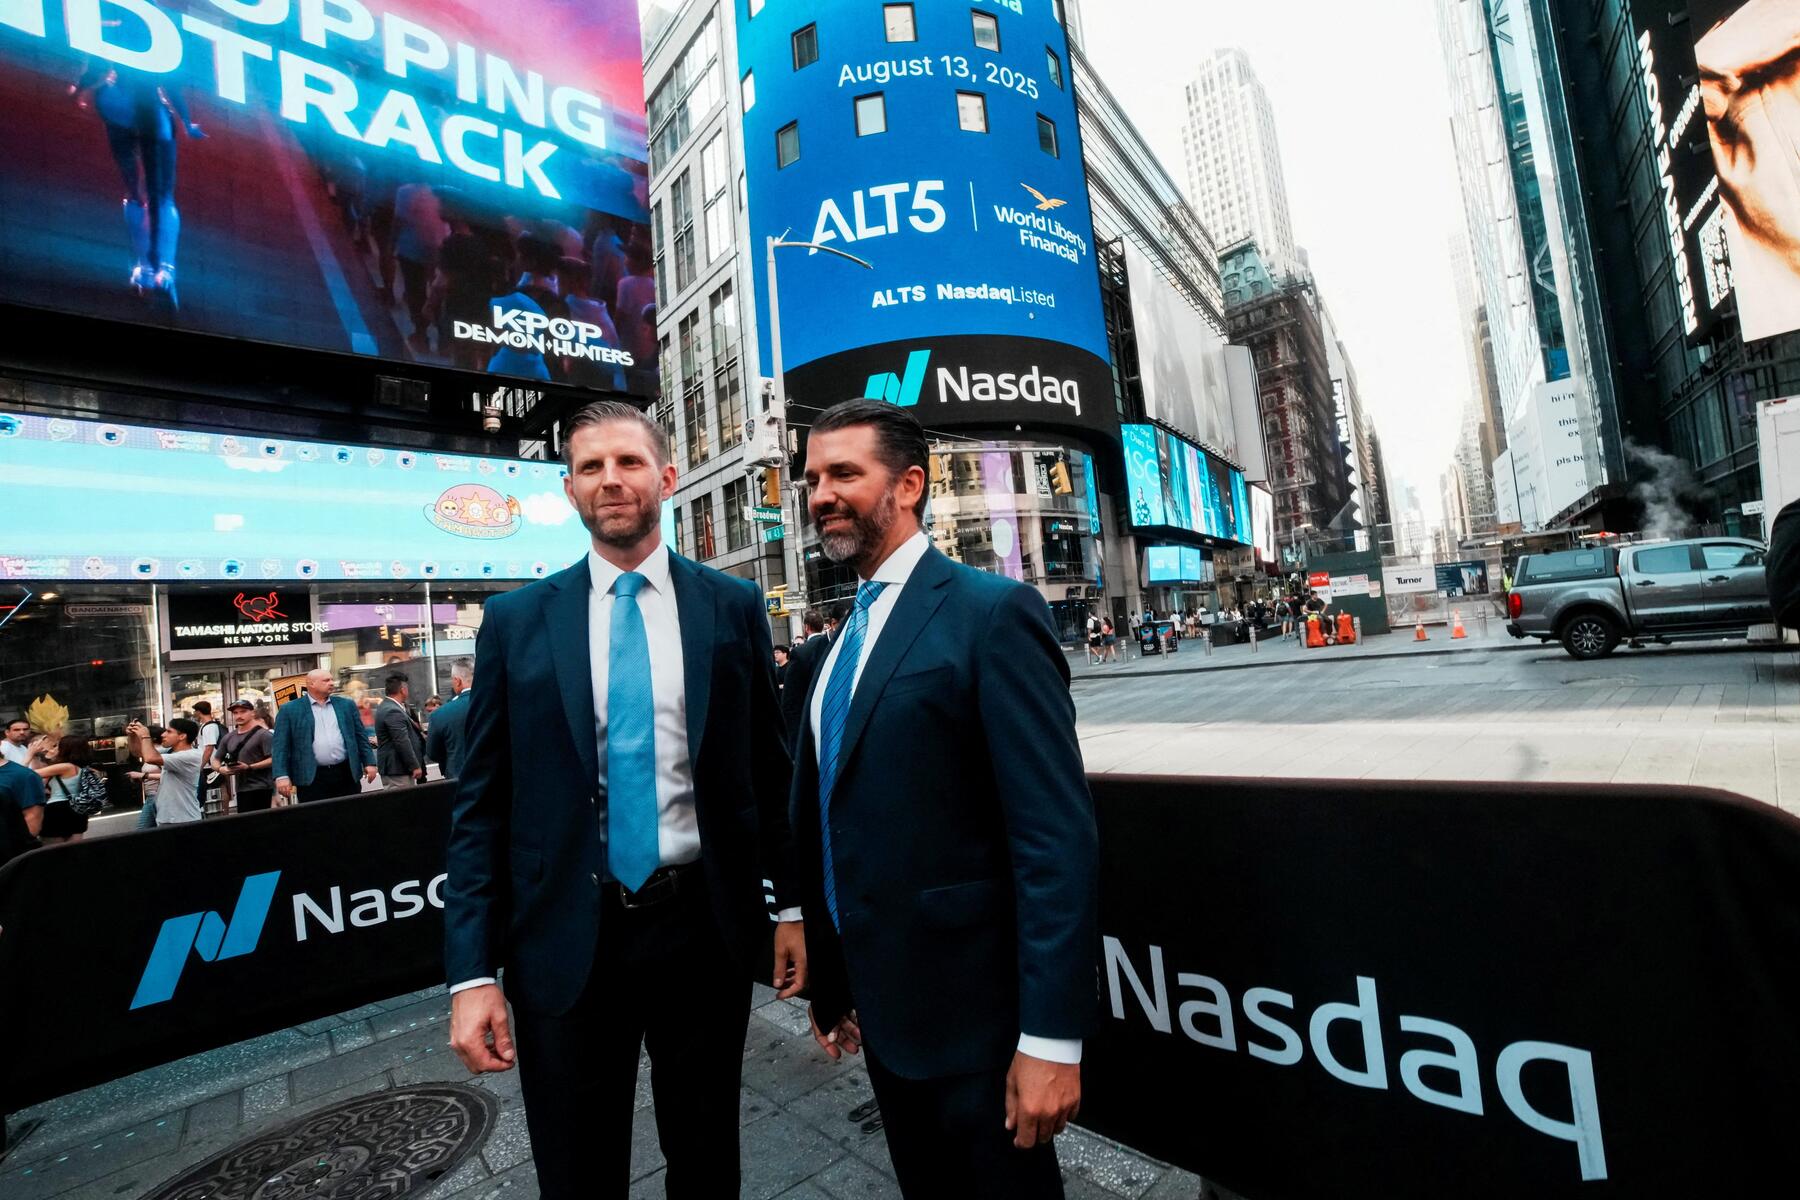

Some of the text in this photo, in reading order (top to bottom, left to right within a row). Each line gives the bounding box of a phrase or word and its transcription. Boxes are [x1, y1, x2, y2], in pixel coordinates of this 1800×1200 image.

[838, 55, 1039, 99] August 13, 2025
[1637, 29, 1698, 337] RESERVE NOW
[808, 179, 946, 256] ALT5
[993, 204, 1087, 255] World Liberty
[1019, 228, 1079, 265] Financial
[871, 285, 926, 308] ALTS
[453, 320, 635, 367] DEMON HUNTERS
[937, 364, 1081, 416] Nasdaq
[1558, 417, 1578, 427] this
[752, 509, 780, 522] Broadway
[1396, 577, 1422, 585] Turner
[224, 634, 290, 645] NEW YORK
[236, 622, 289, 634] NATIONS
[291, 621, 329, 633] STORE
[1102, 935, 1608, 1181] Nasdaq
